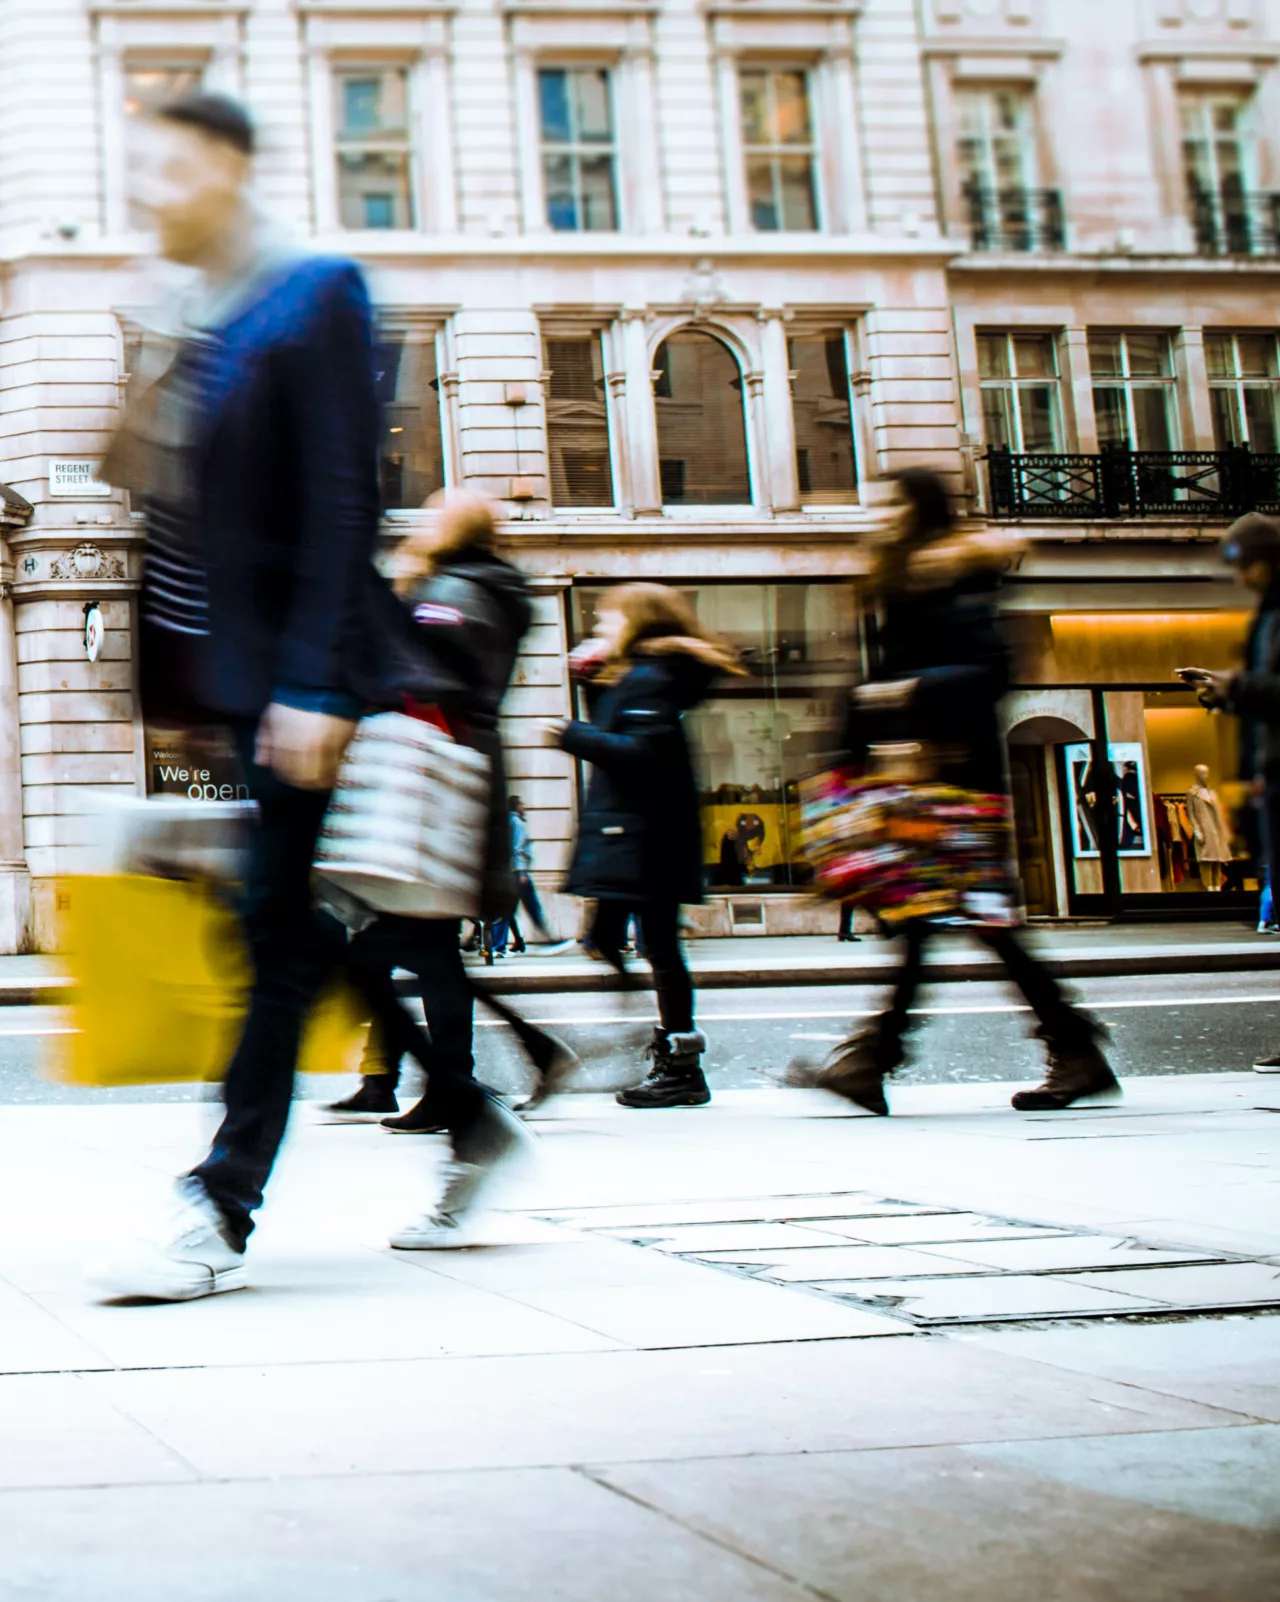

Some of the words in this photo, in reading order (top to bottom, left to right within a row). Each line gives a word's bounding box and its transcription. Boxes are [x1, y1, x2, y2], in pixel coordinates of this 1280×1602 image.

[55, 464, 90, 473] REGENT
[55, 474, 88, 483] STREET
[24, 558, 35, 571] H
[159, 765, 210, 781] We're
[187, 783, 250, 801] open
